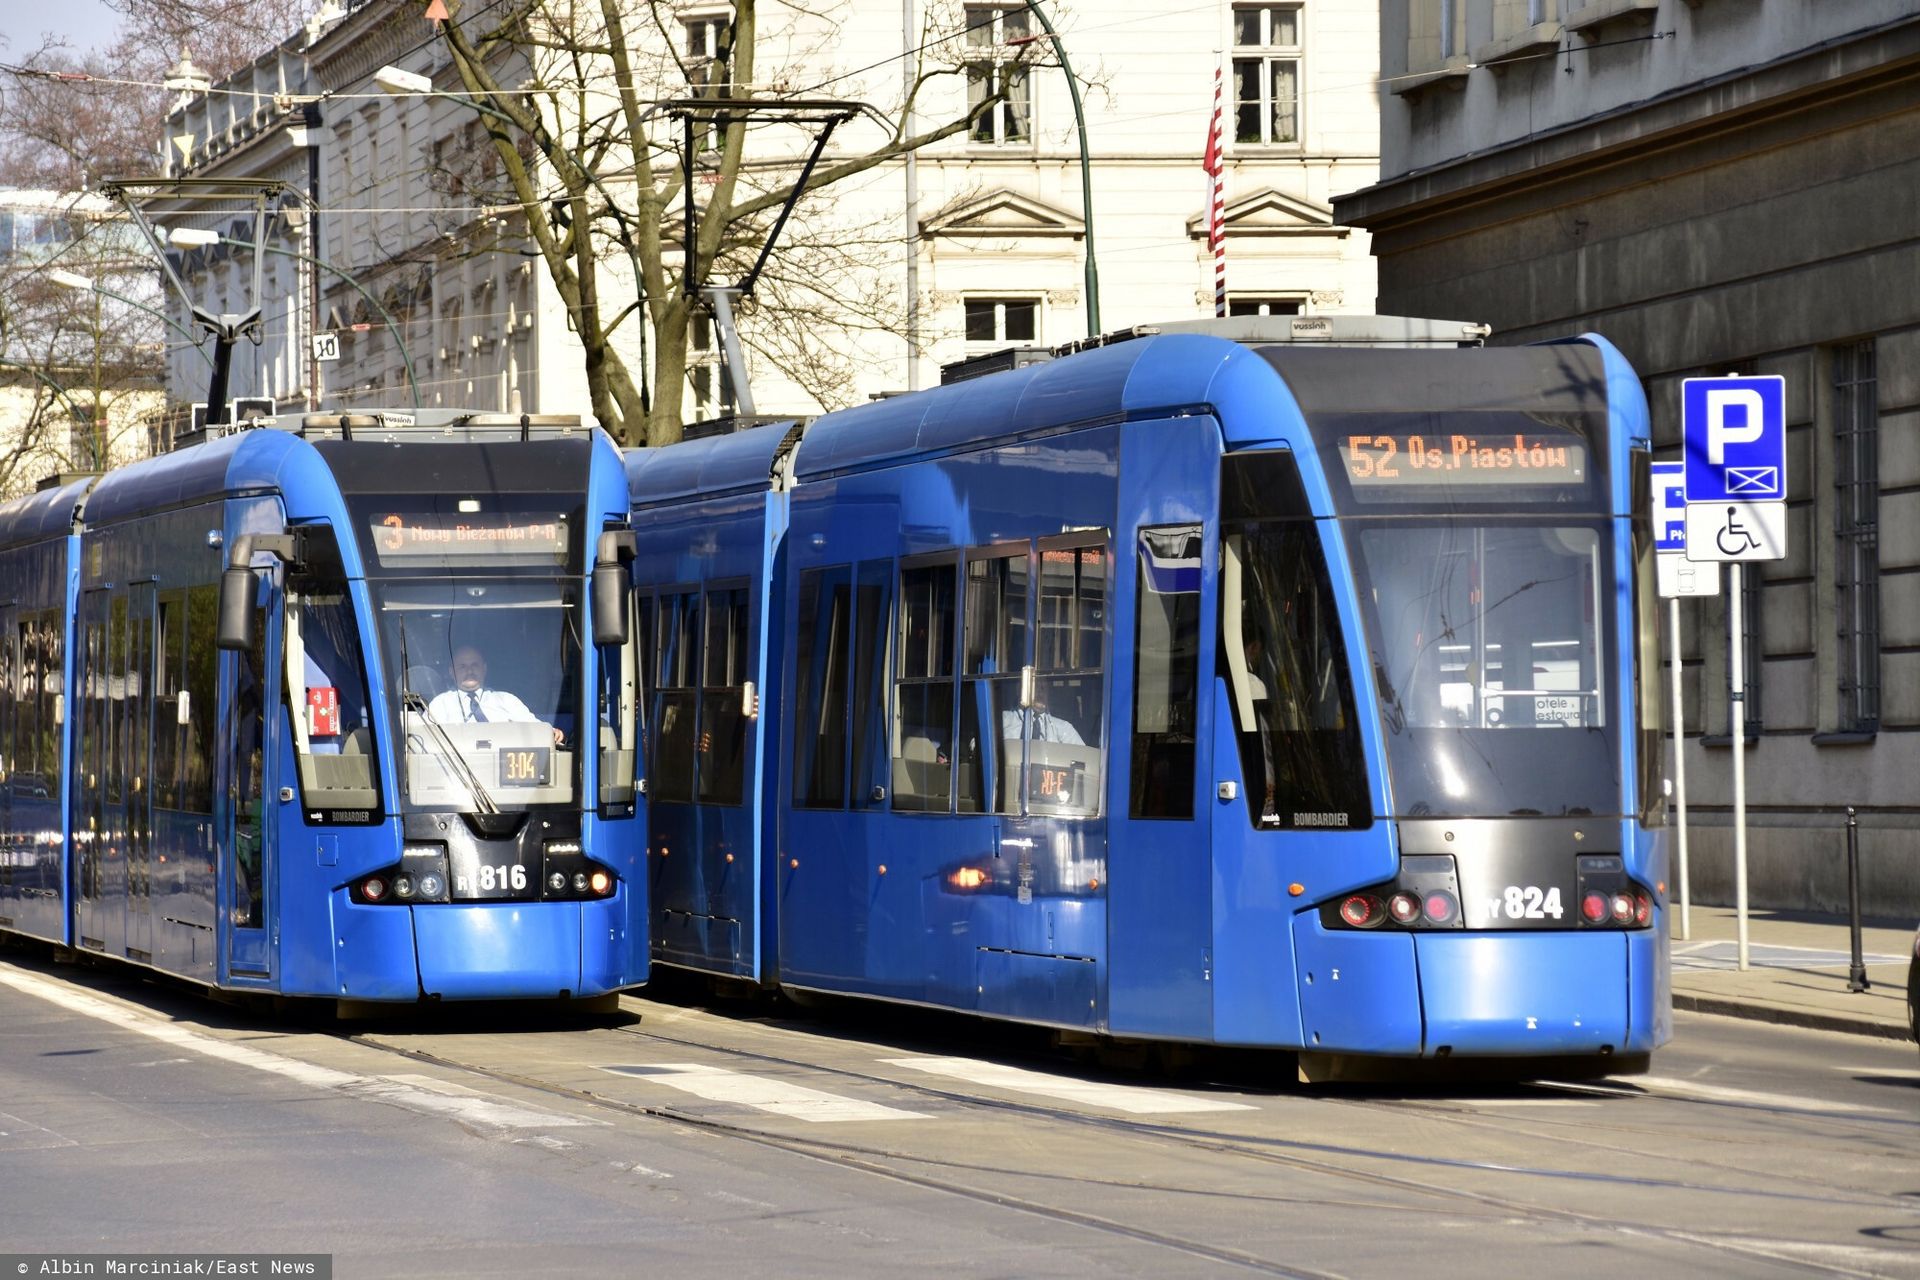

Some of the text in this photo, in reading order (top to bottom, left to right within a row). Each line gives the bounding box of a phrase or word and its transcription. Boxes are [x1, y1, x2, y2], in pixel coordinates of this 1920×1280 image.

[317, 338, 335, 357] 10
[1707, 389, 1764, 465] P
[1349, 435, 1399, 478] 52
[383, 515, 403, 549] 3
[1294, 812, 1349, 826] BOMBARDIER
[480, 865, 527, 890] 816
[1504, 886, 1564, 919] 824
